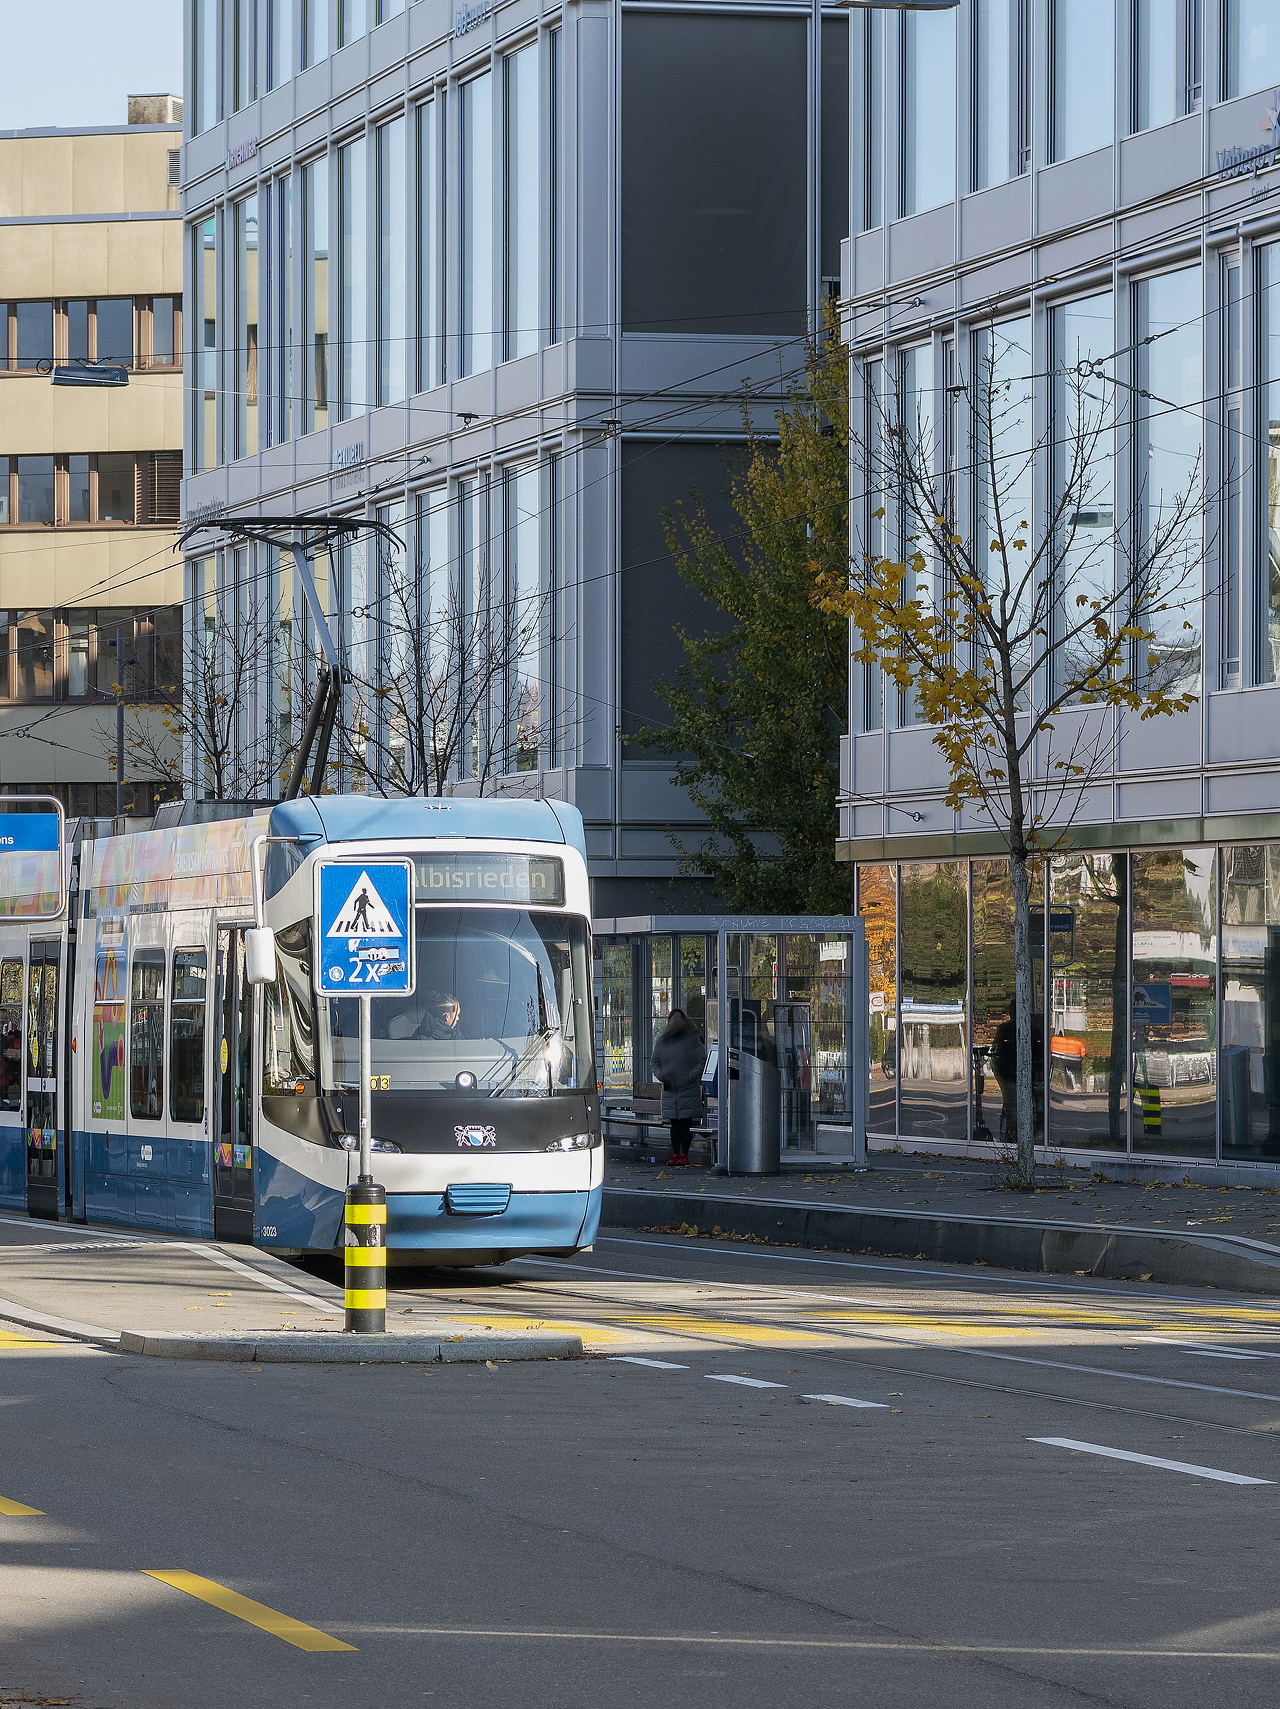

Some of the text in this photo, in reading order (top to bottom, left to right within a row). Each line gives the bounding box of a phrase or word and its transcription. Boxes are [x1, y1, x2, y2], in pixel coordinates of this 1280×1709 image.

[1216, 143, 1266, 180] Vebego
[348, 956, 381, 982] 2x
[263, 1225, 277, 1237] 3023
